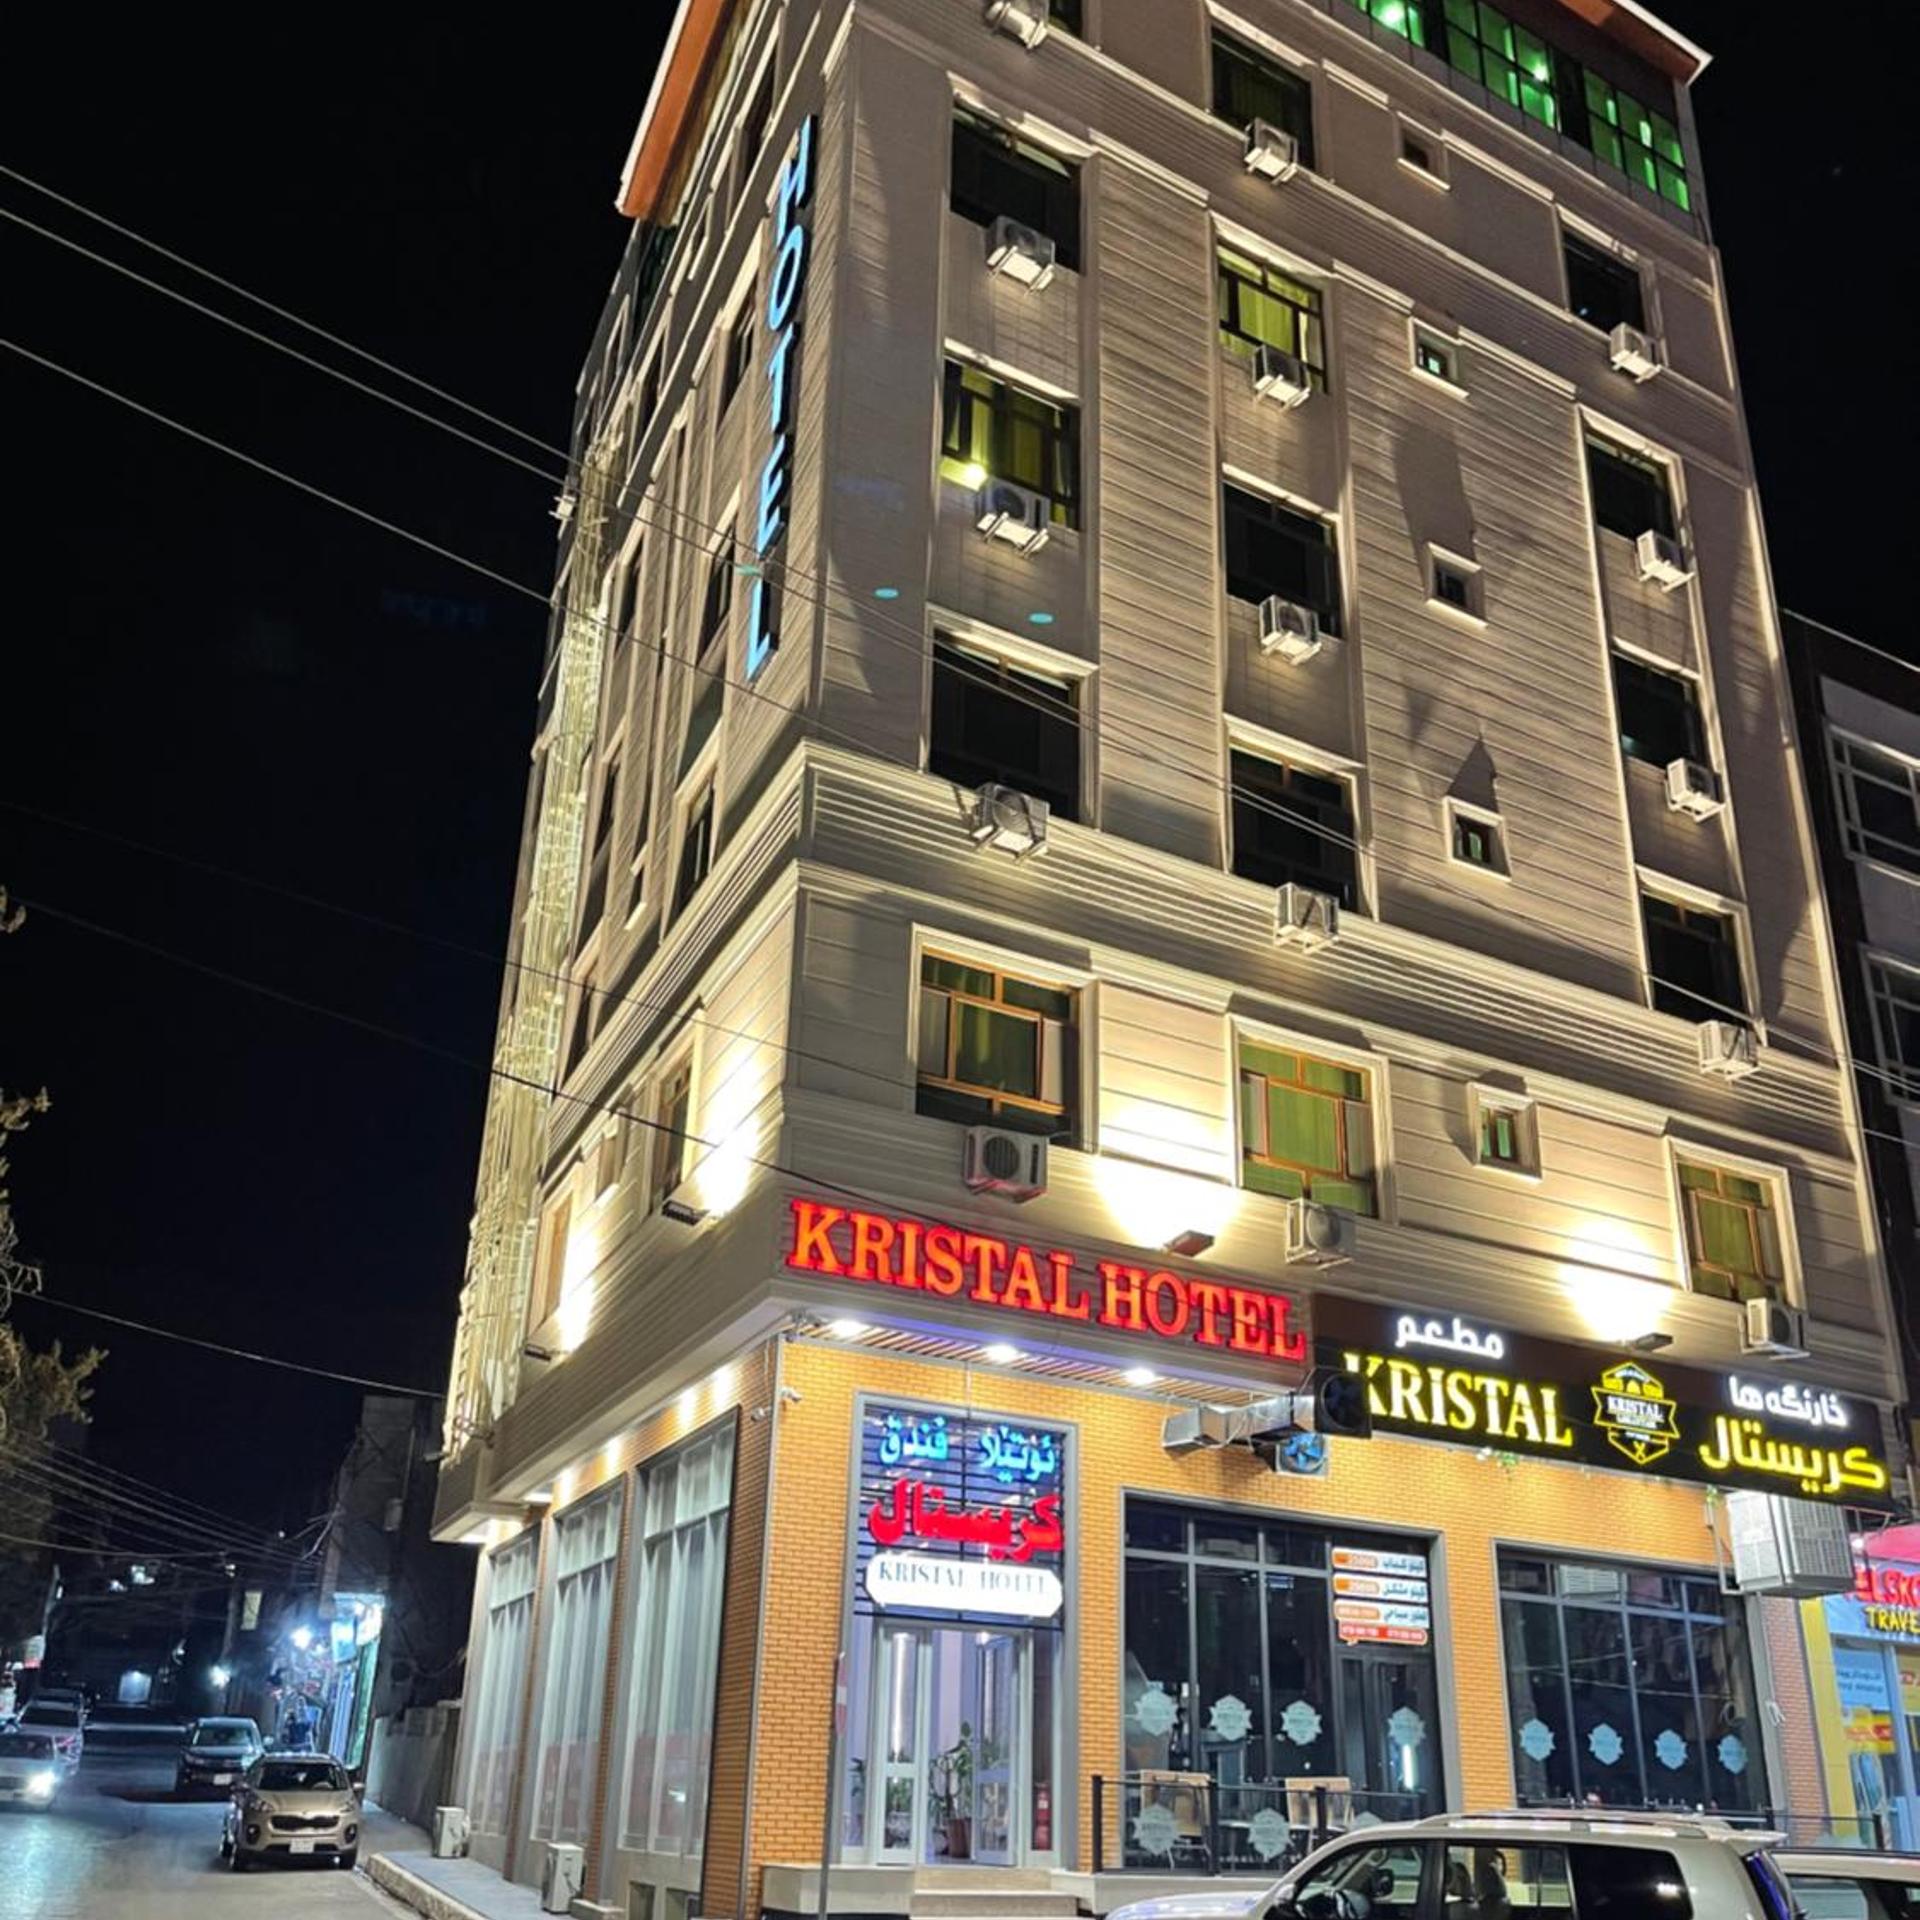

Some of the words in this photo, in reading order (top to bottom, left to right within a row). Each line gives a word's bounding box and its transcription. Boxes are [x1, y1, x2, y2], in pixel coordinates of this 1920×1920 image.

[745, 113, 815, 681] HOTEL
[785, 1200, 1091, 1321] KRISTAL
[1097, 1259, 1306, 1361] HOTEL
[1395, 1315, 1505, 1360] مطعم
[879, 1413, 949, 1466] فندق
[1343, 1352, 1573, 1447] KRISTAL
